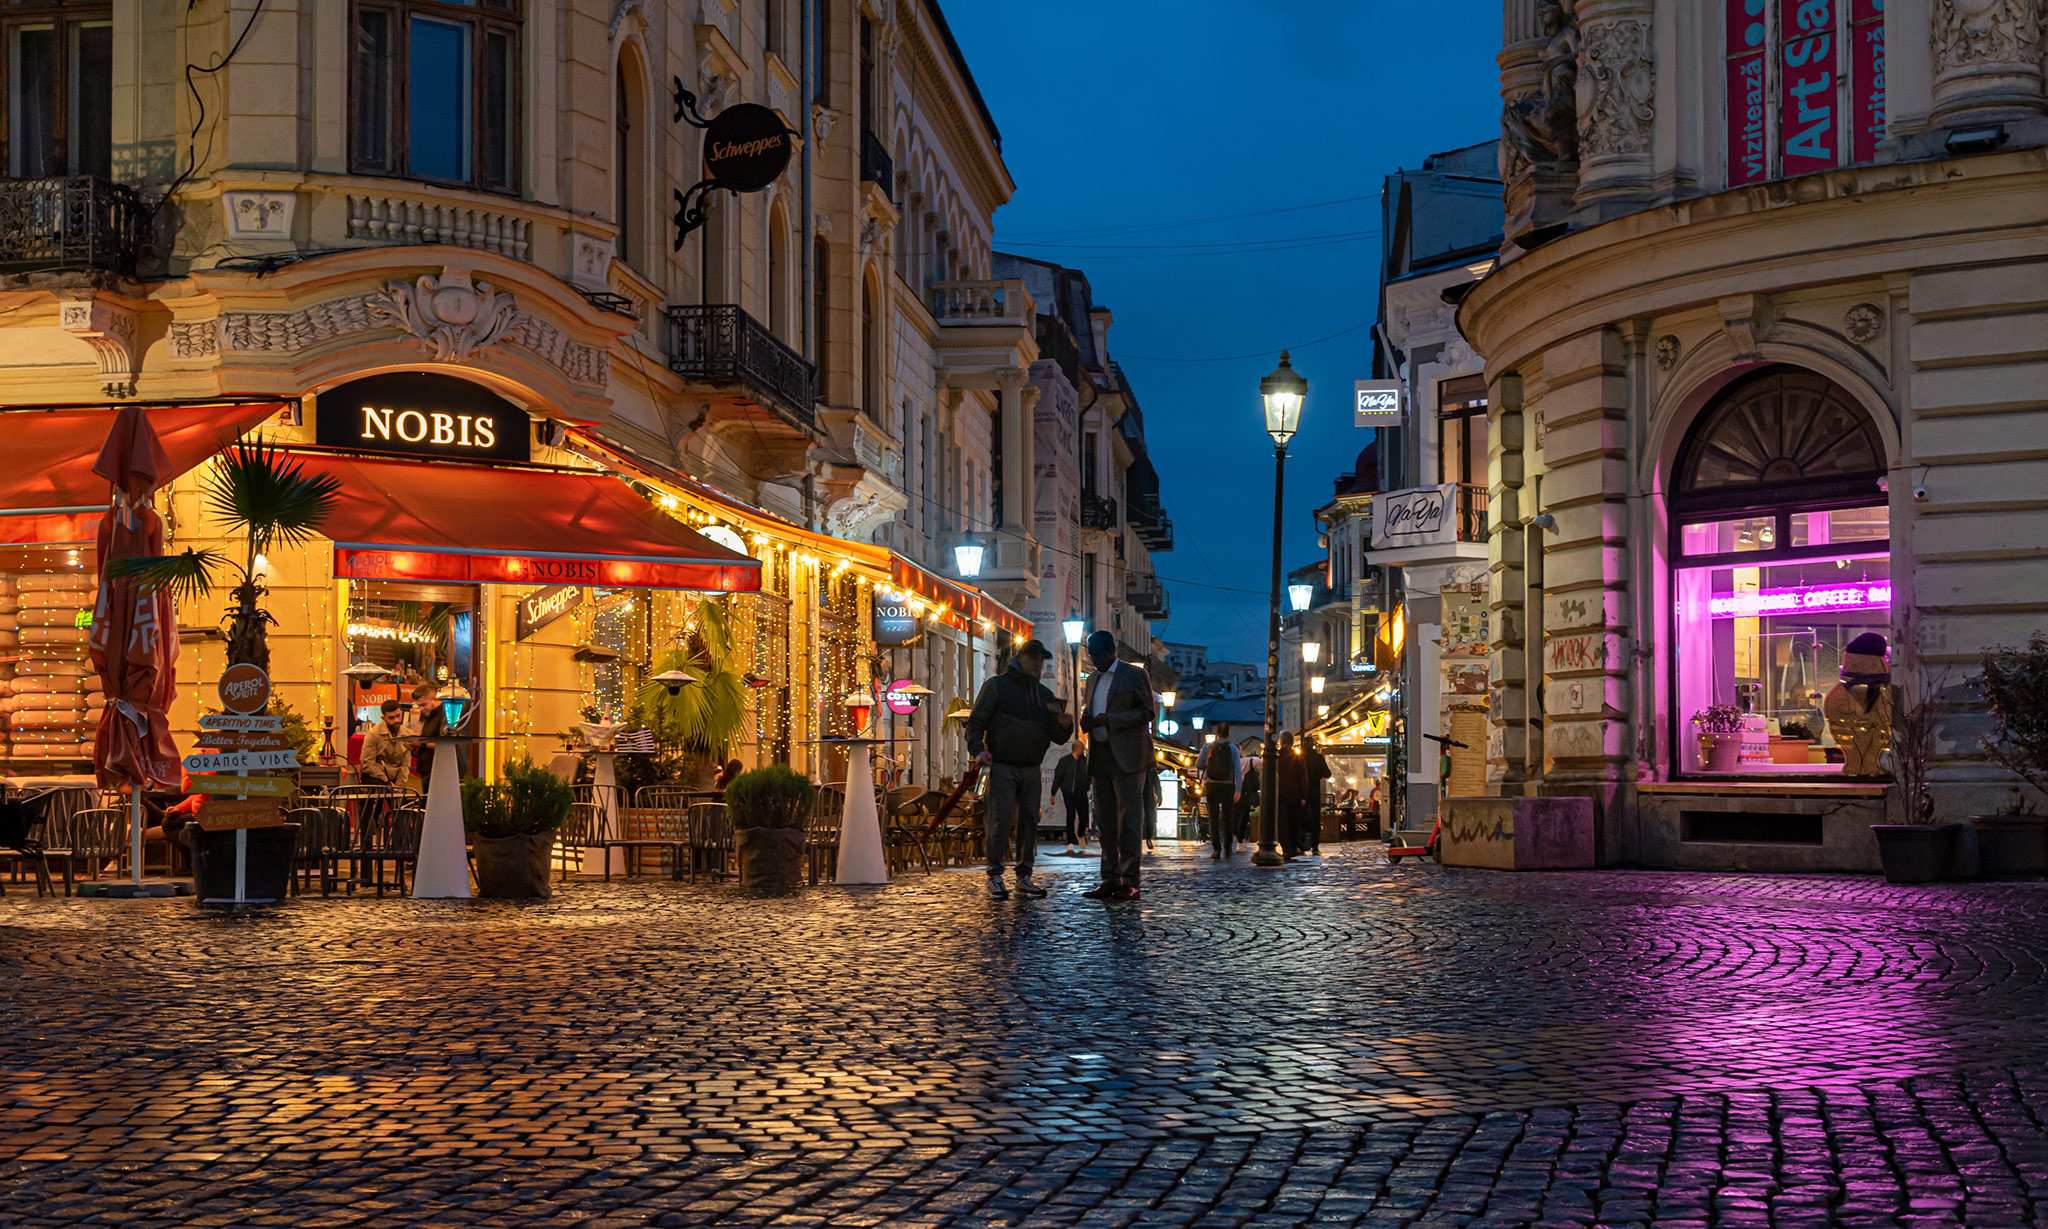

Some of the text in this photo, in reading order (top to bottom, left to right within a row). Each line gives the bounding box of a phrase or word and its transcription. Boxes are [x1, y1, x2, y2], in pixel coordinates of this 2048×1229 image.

[1785, 0, 1831, 160] Art Sa
[1740, 57, 1763, 178] vizitează
[710, 134, 783, 162] Schweppes
[361, 406, 496, 448] NOBIS
[345, 554, 390, 570] APEROL
[532, 560, 596, 578] NOBIS
[876, 606, 913, 618] NOBI
[224, 677, 264, 696] APEROL
[231, 687, 258, 701] SPRITZ
[204, 717, 277, 729] APERITIVO TIME
[201, 734, 281, 748] Better Together
[189, 753, 291, 769] ORANGE VIBE
[220, 780, 243, 791] with
[244, 780, 279, 796] friends
[247, 812, 273, 824] SMILE
[1340, 822, 1369, 832] NESS
